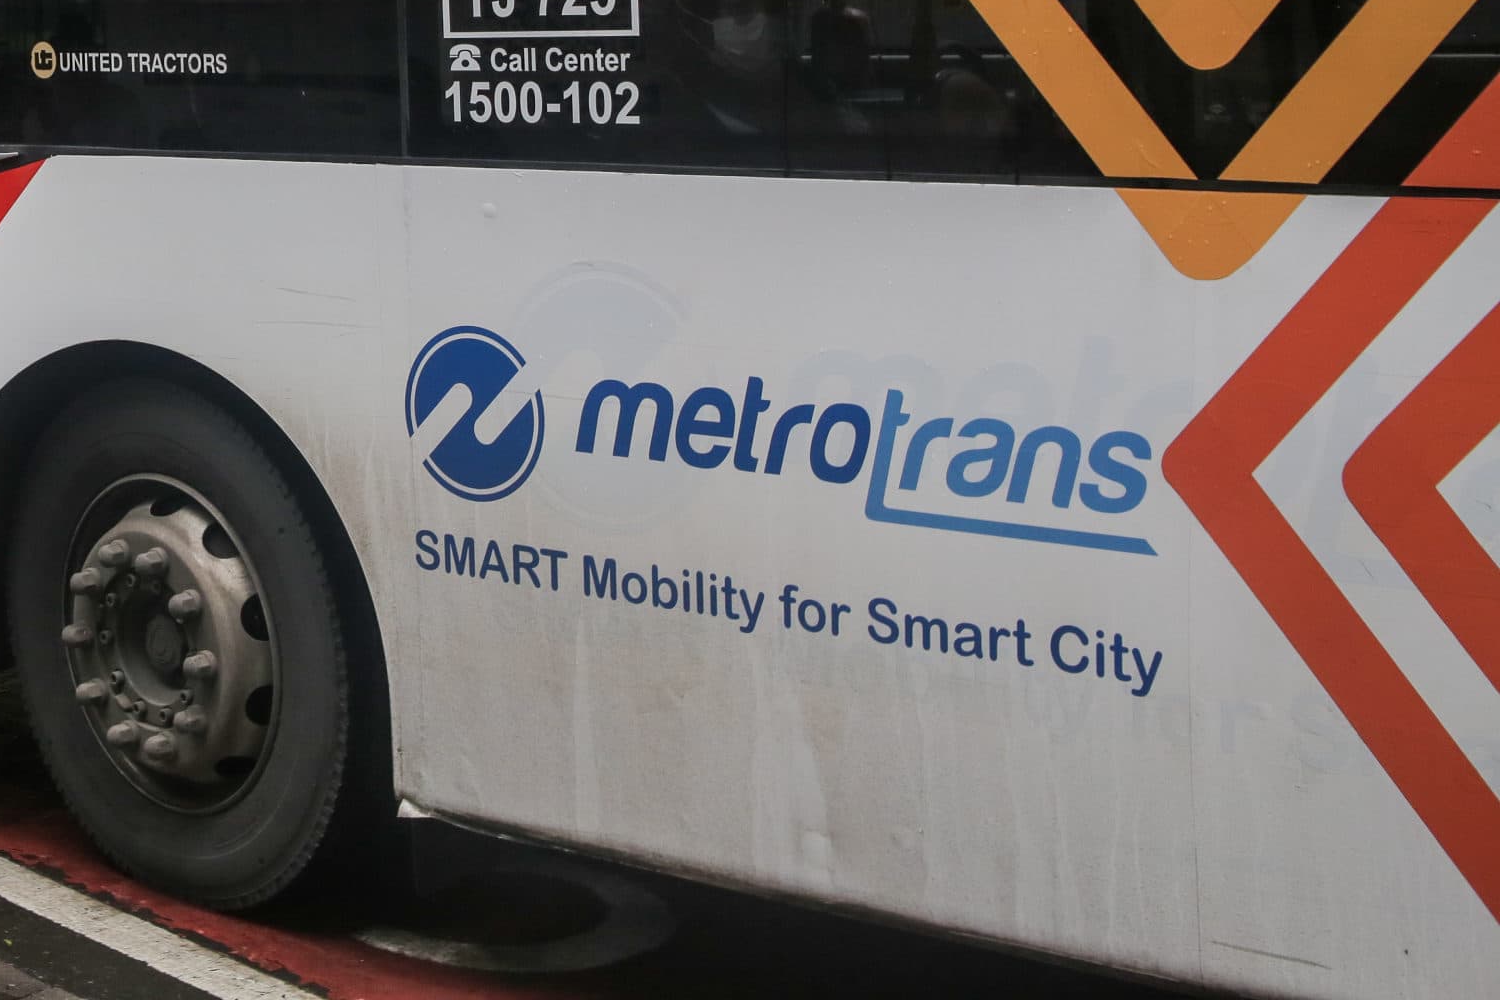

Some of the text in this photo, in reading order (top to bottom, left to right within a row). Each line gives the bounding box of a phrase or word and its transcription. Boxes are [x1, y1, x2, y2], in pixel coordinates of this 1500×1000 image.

[59, 52, 123, 74] UNITED
[127, 52, 228, 75] TRACTORS
[490, 47, 631, 72] Call Center
[444, 80, 641, 125] 1500-102
[574, 375, 1159, 556] metrotrans
[413, 528, 1164, 699] SMART Mobility for Smart City
